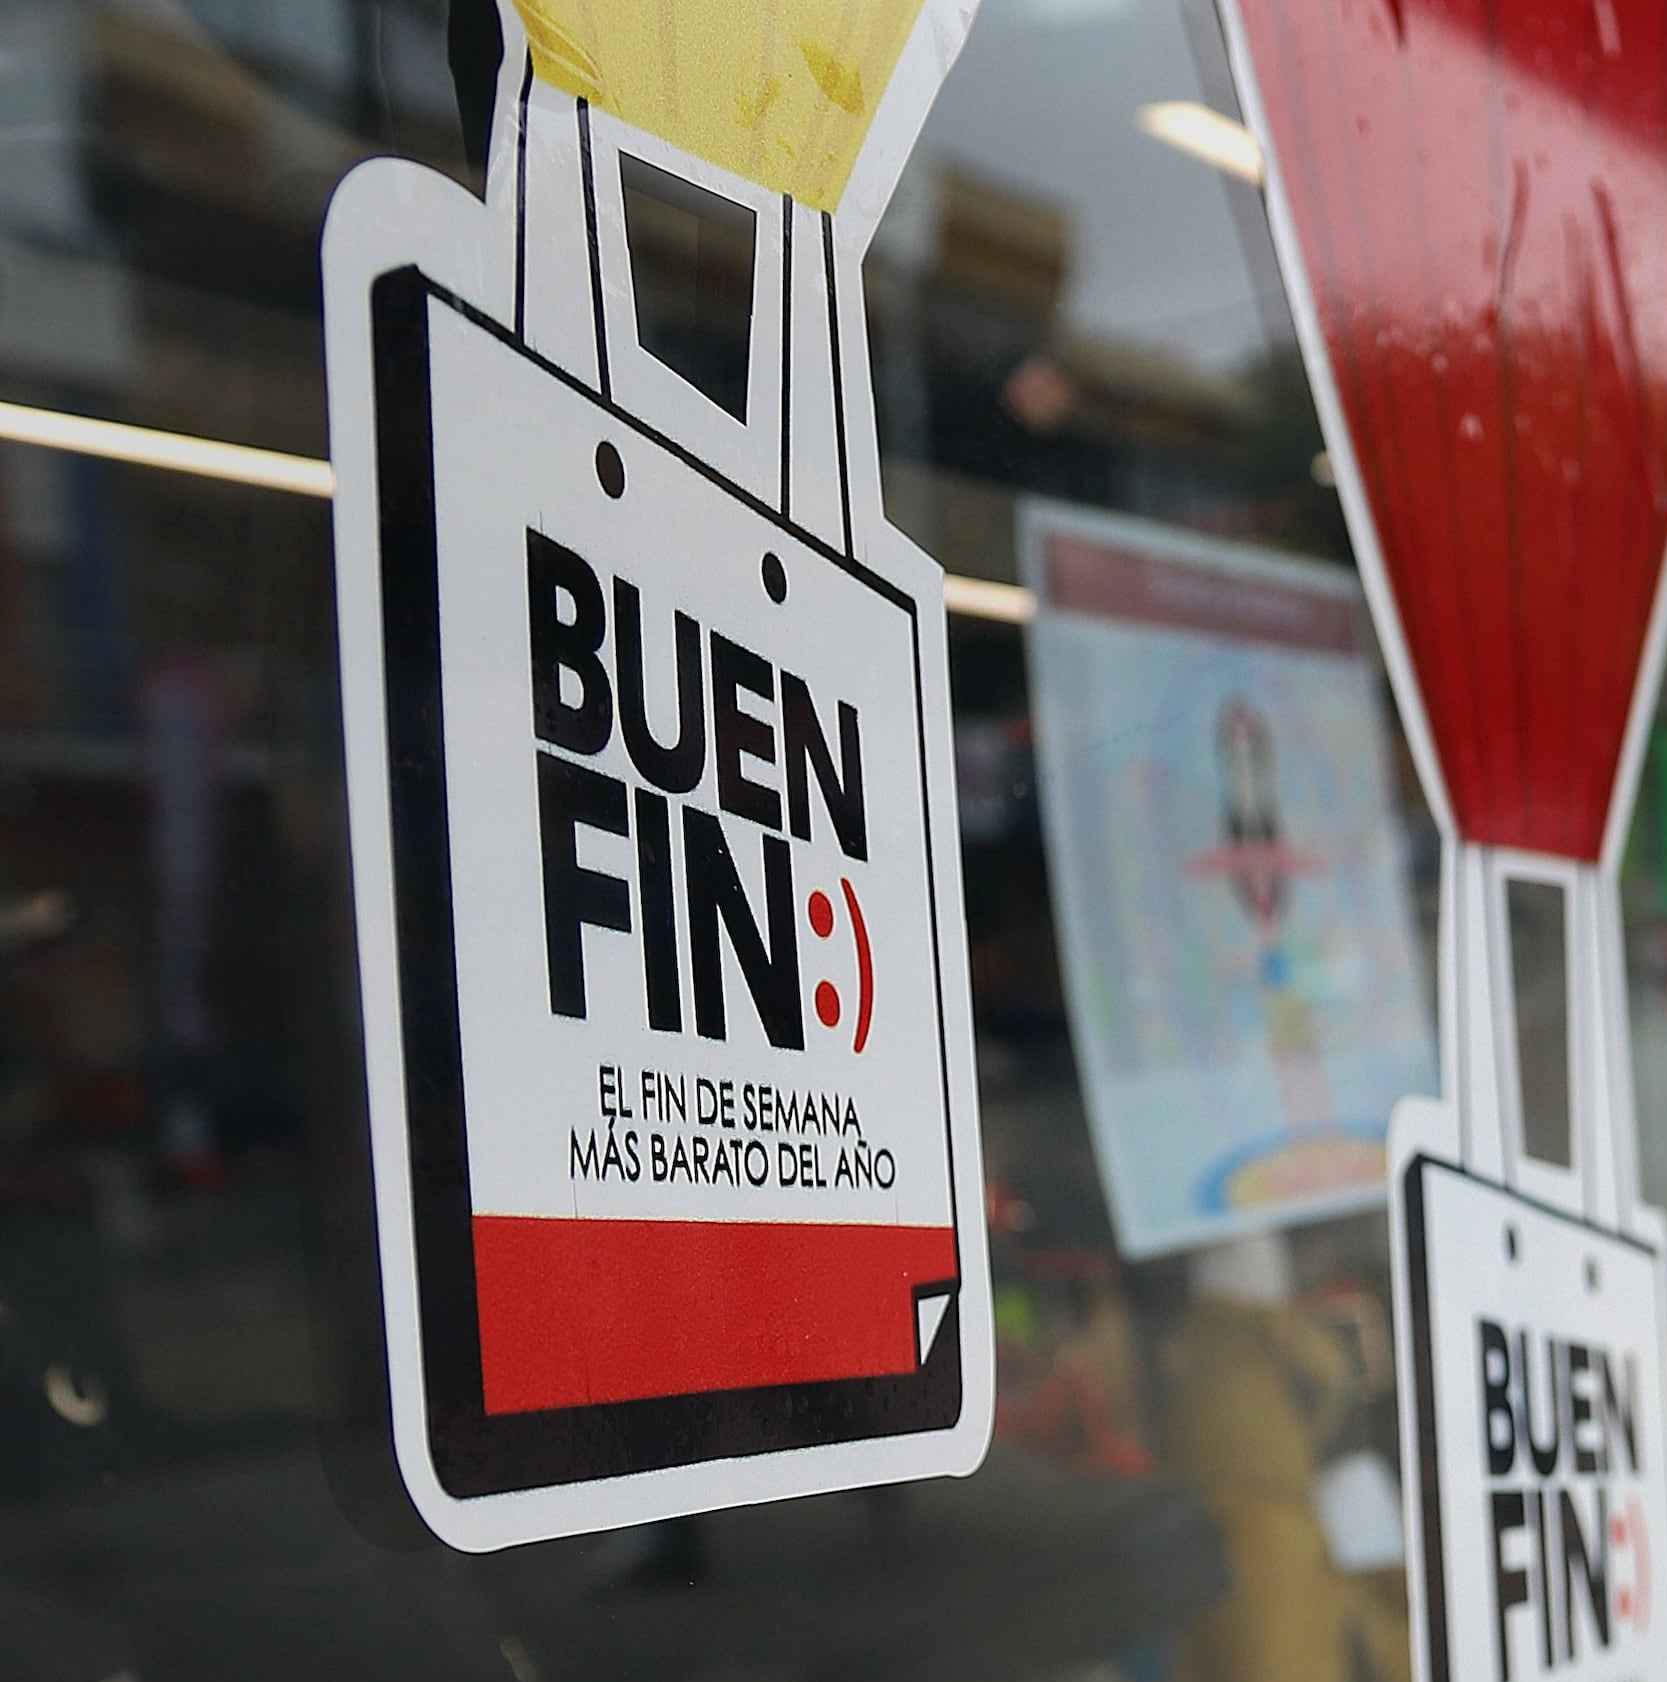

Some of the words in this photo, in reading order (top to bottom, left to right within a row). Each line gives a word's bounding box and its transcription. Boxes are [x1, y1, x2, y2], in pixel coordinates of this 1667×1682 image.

[527, 526, 868, 862] BUEN
[570, 1115, 641, 1182] MÁS
[651, 1133, 770, 1187] BARATO
[777, 1142, 828, 1188] DEL
[833, 1139, 896, 1189] AÑO
[600, 1064, 632, 1118] EL
[641, 1070, 686, 1122] FIN
[697, 1077, 736, 1128] DE
[742, 1080, 862, 1138] SEMANA
[1478, 1318, 1639, 1477] BUEN
